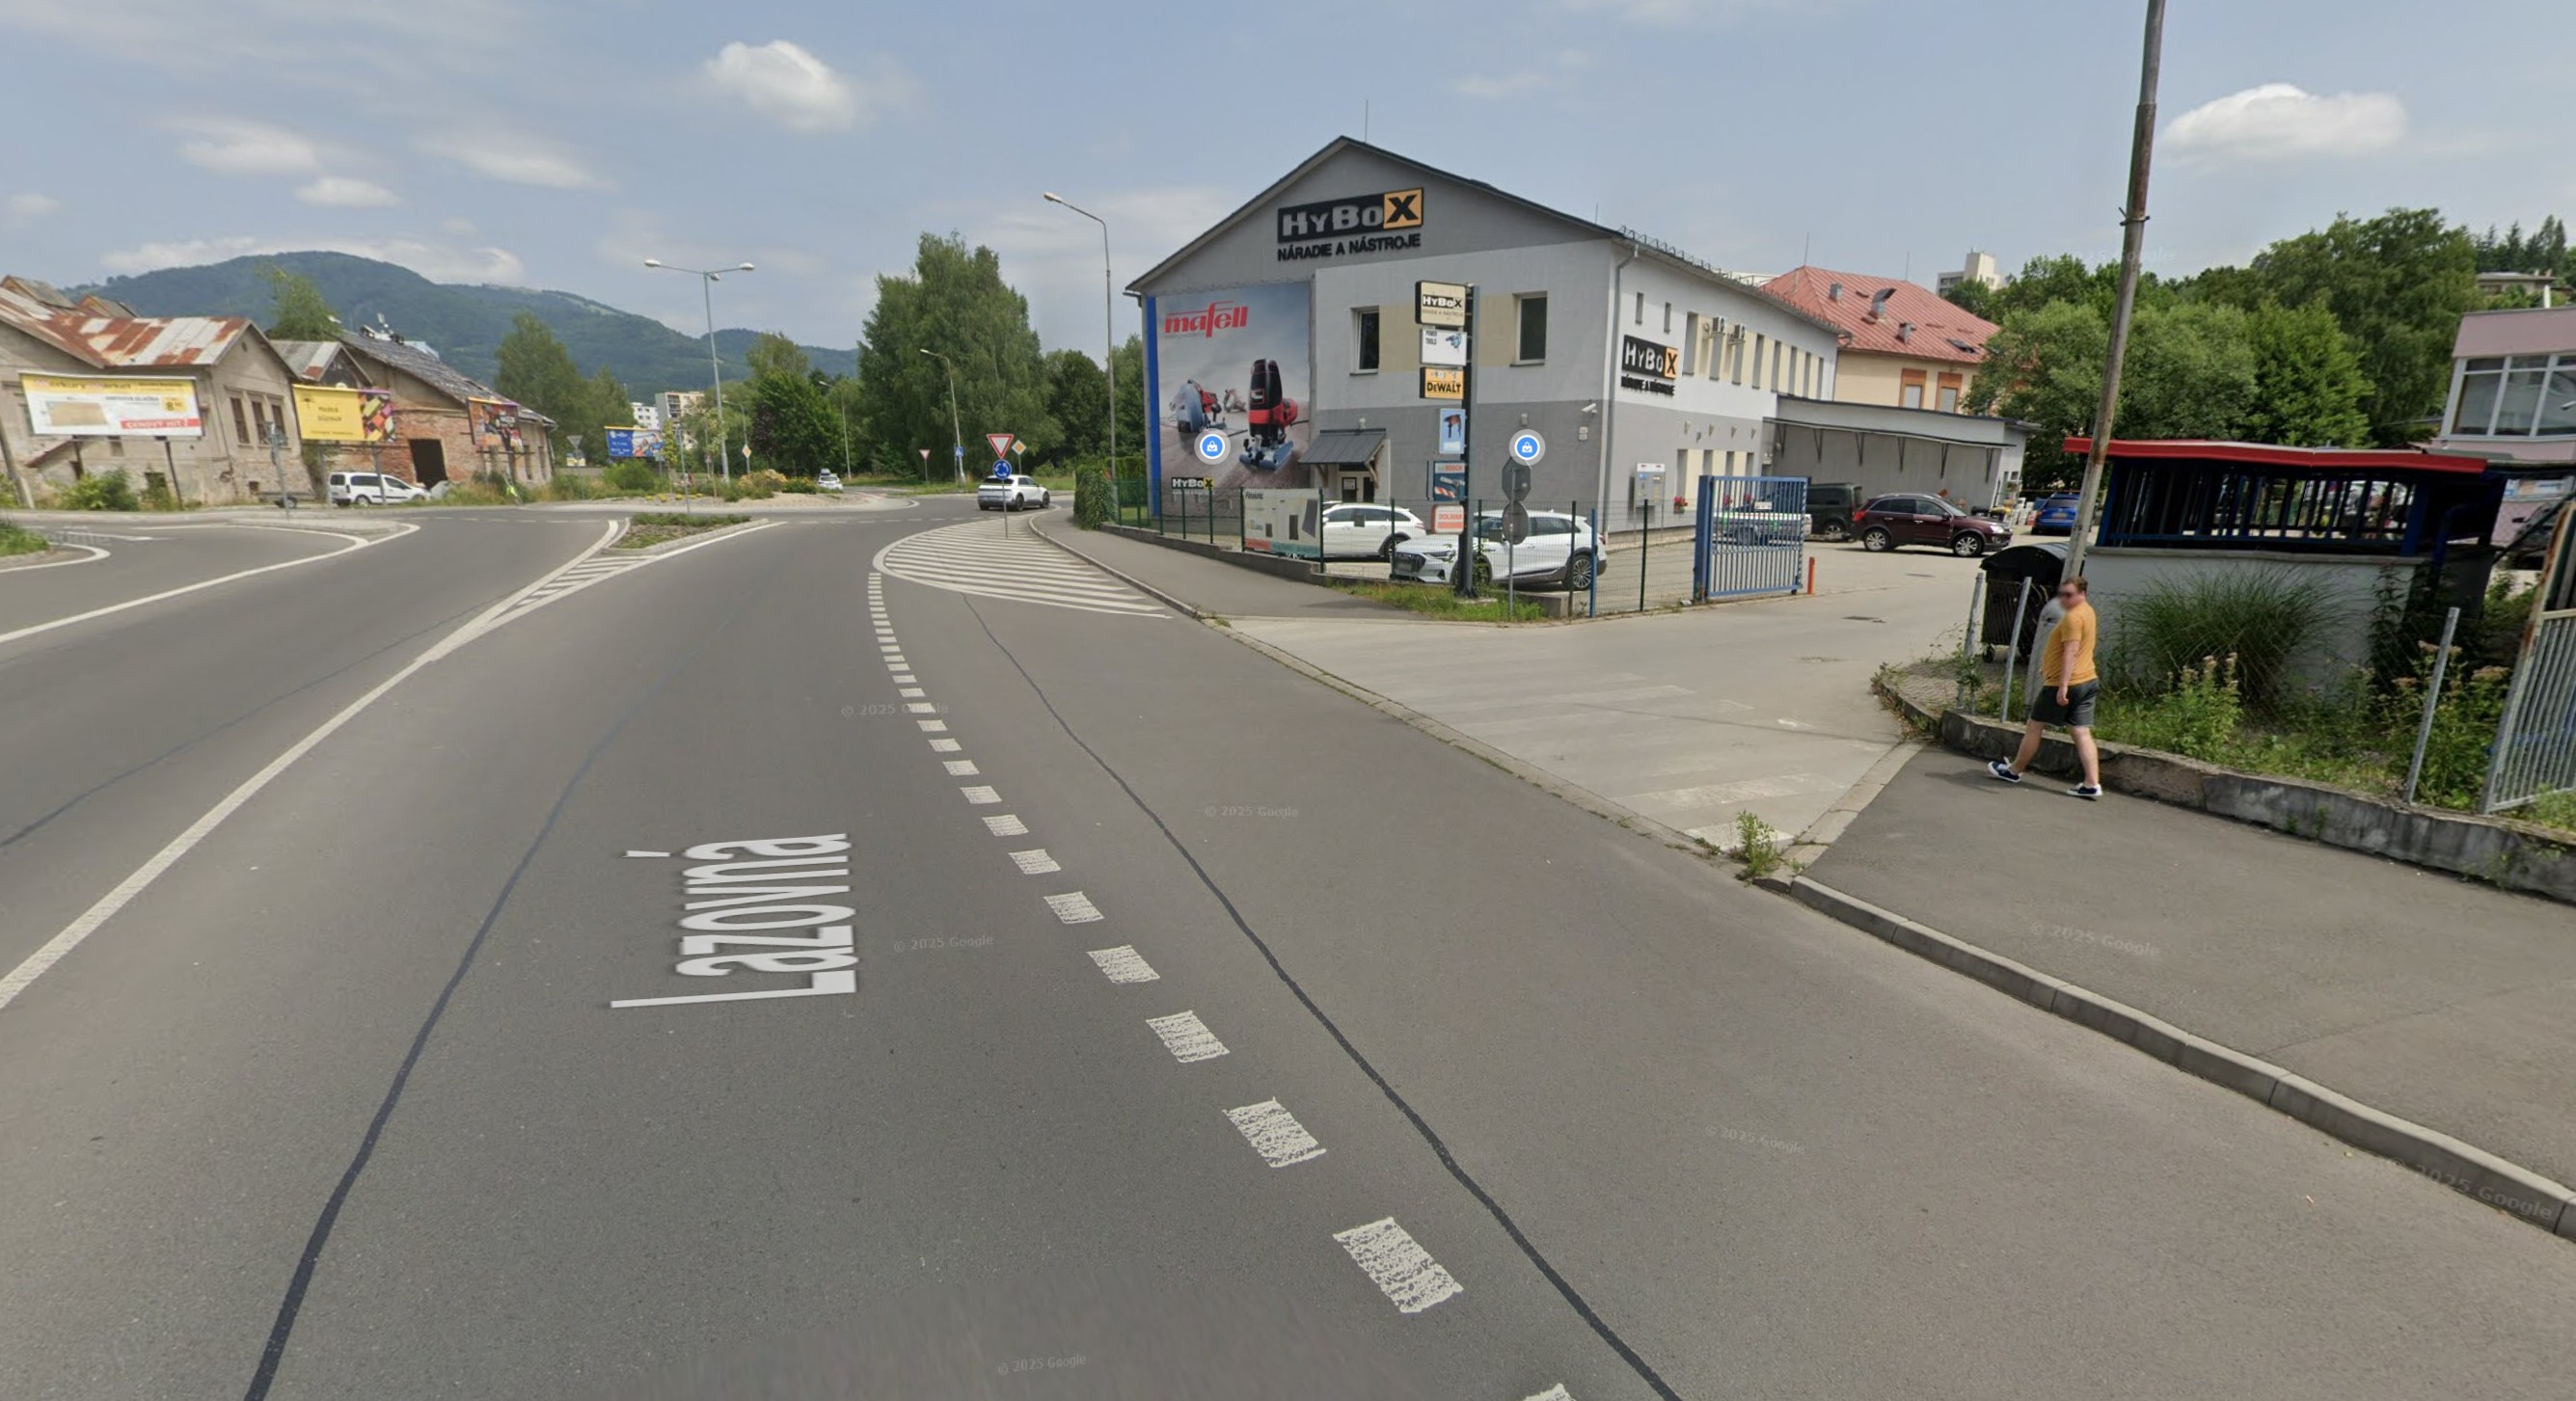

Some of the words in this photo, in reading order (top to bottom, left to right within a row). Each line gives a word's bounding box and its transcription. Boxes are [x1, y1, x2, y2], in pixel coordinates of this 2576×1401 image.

[1277, 242, 1332, 261] NÁRADIE
[1336, 243, 1345, 256] A
[1349, 233, 1422, 255] NÁSTROJE
[1164, 301, 1249, 338] mafell
